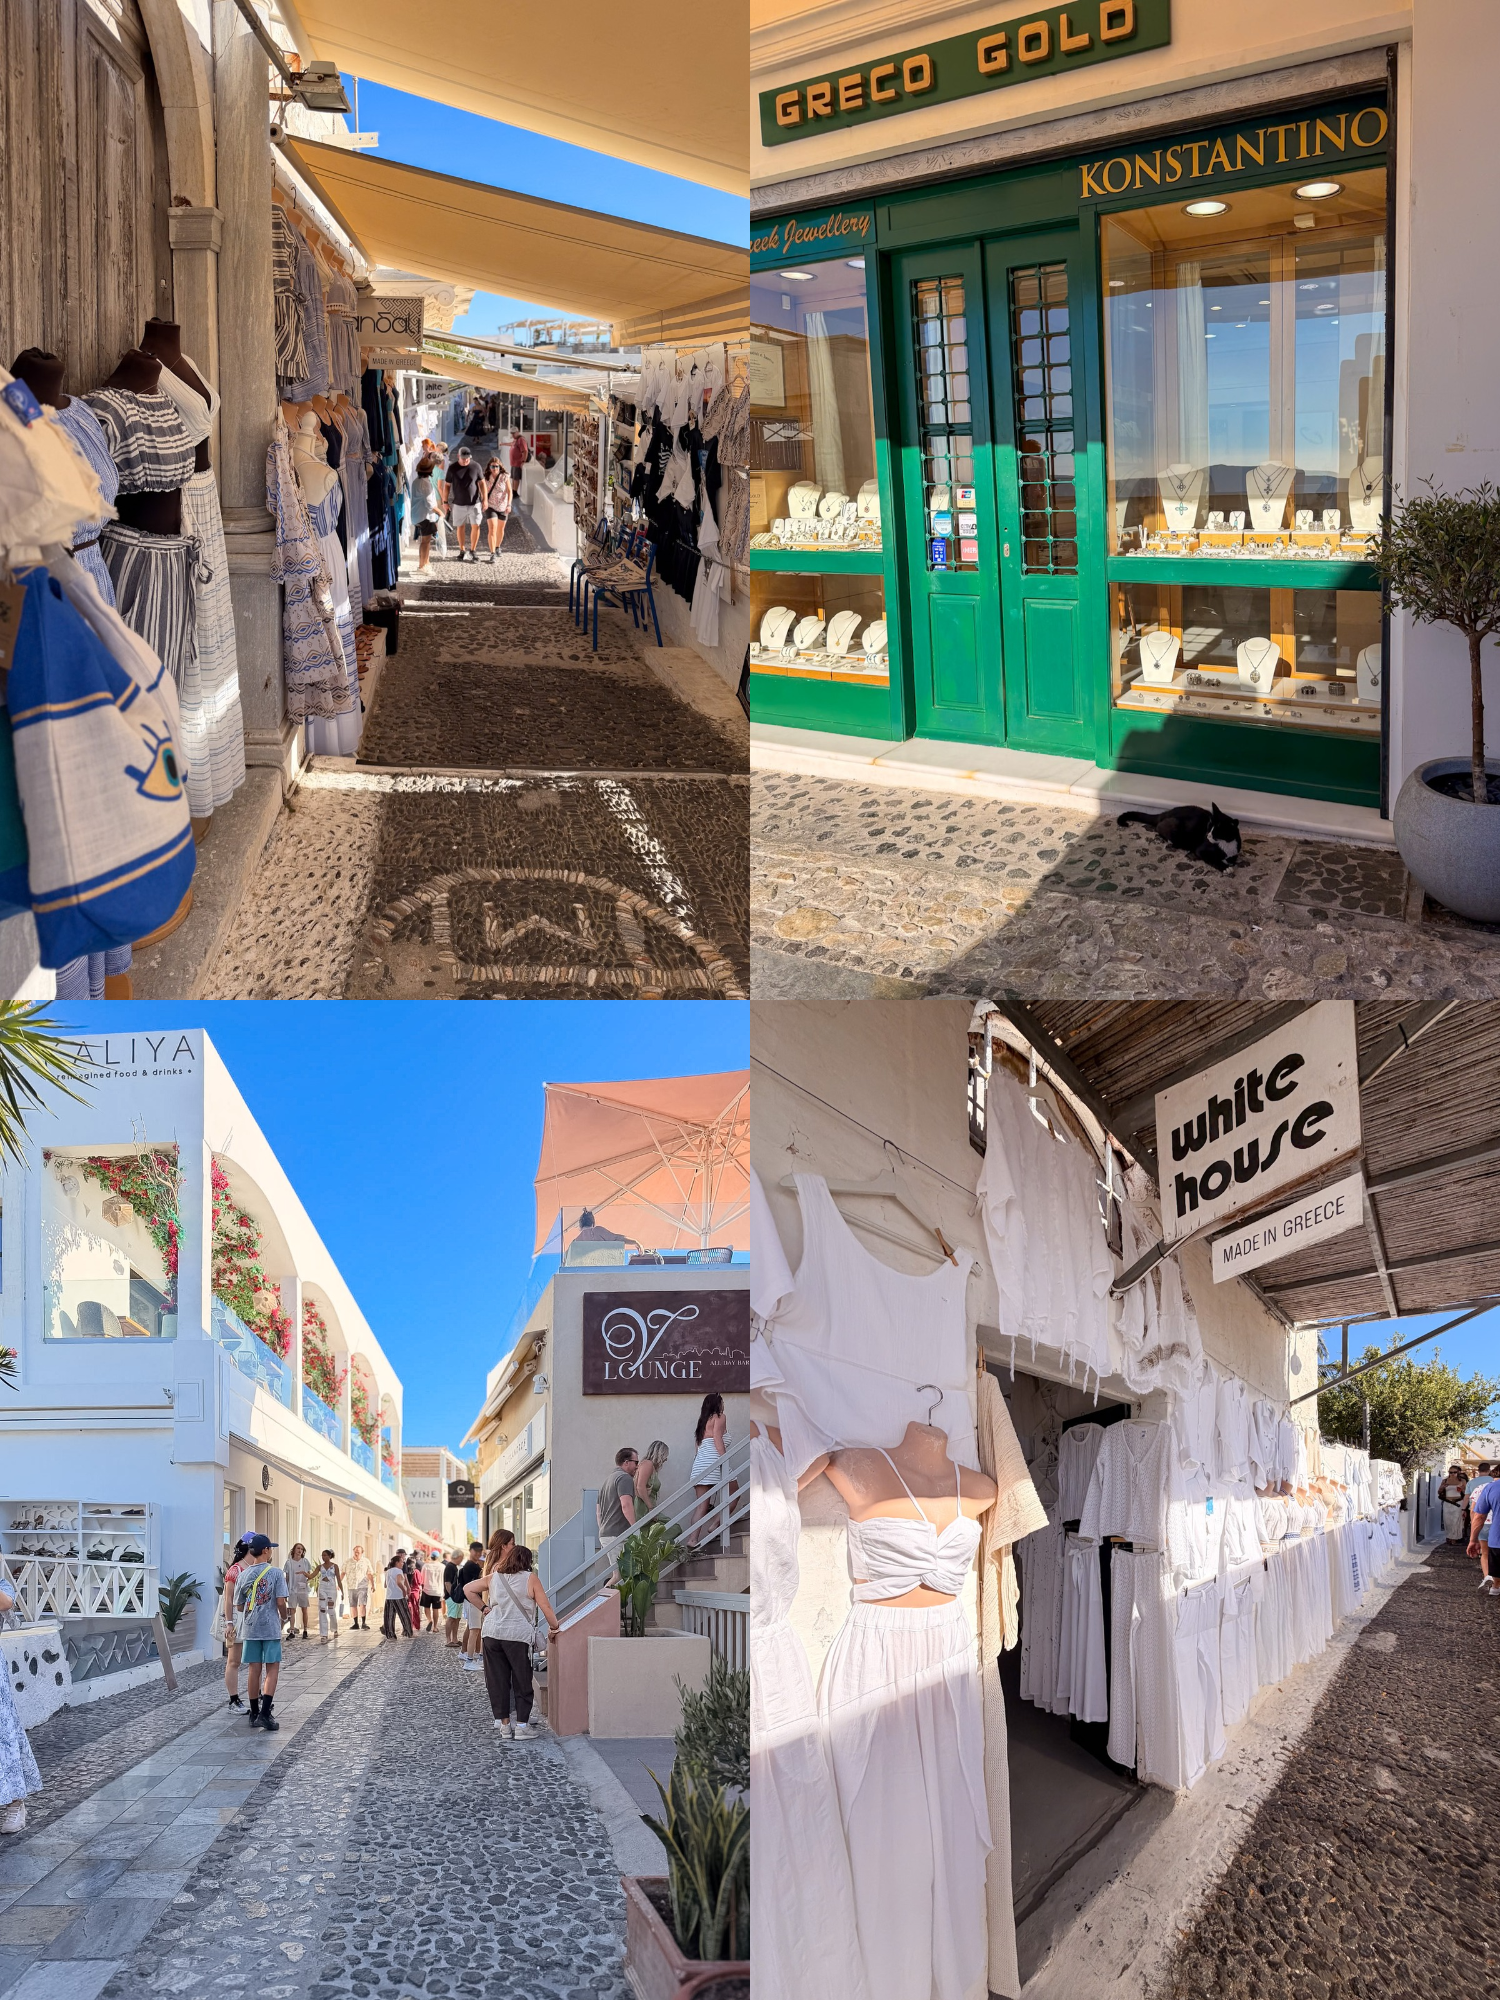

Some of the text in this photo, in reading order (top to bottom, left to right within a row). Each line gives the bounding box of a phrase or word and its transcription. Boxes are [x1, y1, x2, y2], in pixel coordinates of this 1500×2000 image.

[774, 0, 1136, 128] GRECO GOLD
[1079, 107, 1388, 199] KONSTANTINO
[782, 212, 871, 254] Jewellery
[395, 358, 416, 366] GREECE
[44, 1035, 195, 1067] ALIYA
[114, 1069, 138, 1078] food
[152, 1068, 183, 1076] drinks
[1171, 1052, 1306, 1162] white
[1175, 1100, 1335, 1219] house
[1223, 1195, 1345, 1265] MADE IN GREECE
[604, 1360, 702, 1380] LOUNGE
[411, 1490, 437, 1499] VINE
